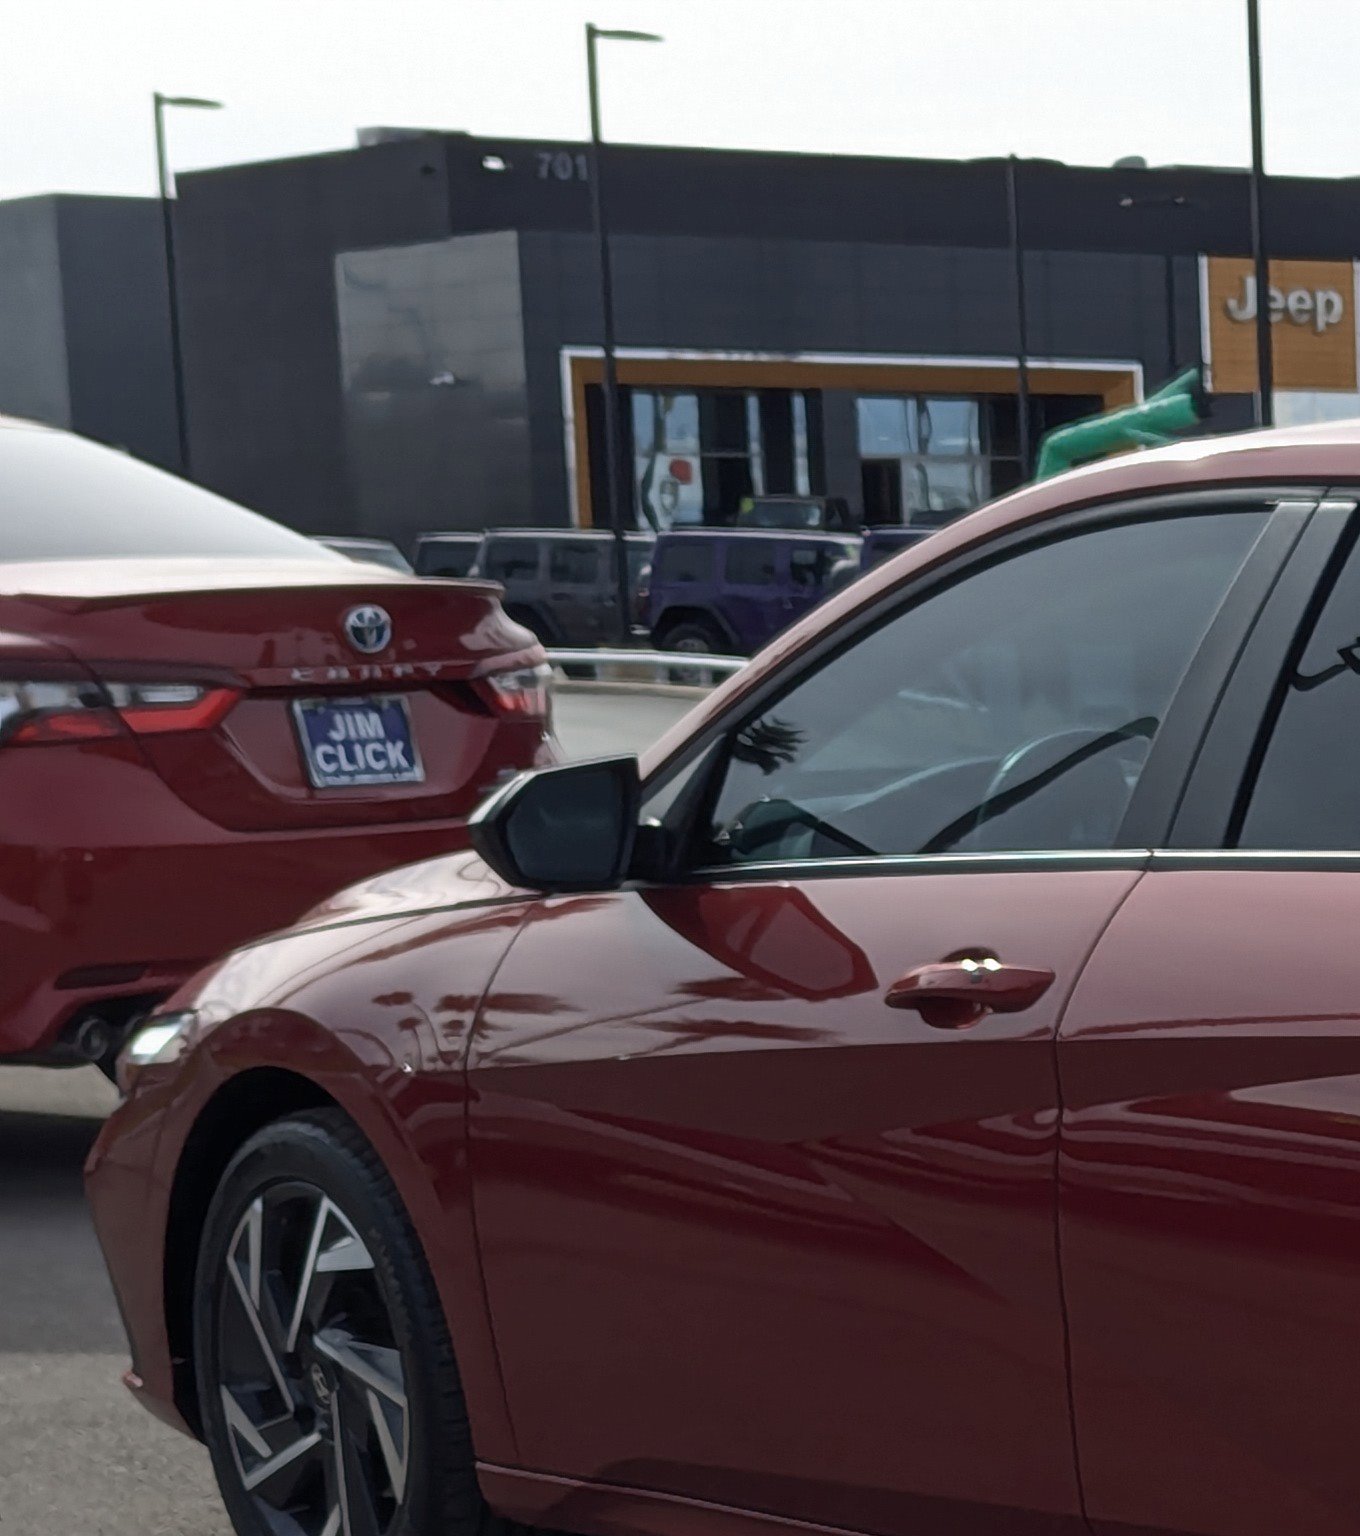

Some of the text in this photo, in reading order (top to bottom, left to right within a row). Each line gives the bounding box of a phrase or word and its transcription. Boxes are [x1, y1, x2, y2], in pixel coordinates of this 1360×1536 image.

[538, 152, 588, 180] 701
[1227, 275, 1343, 332] Jeep
[327, 711, 386, 742] JIM
[315, 740, 411, 773] CLICK
